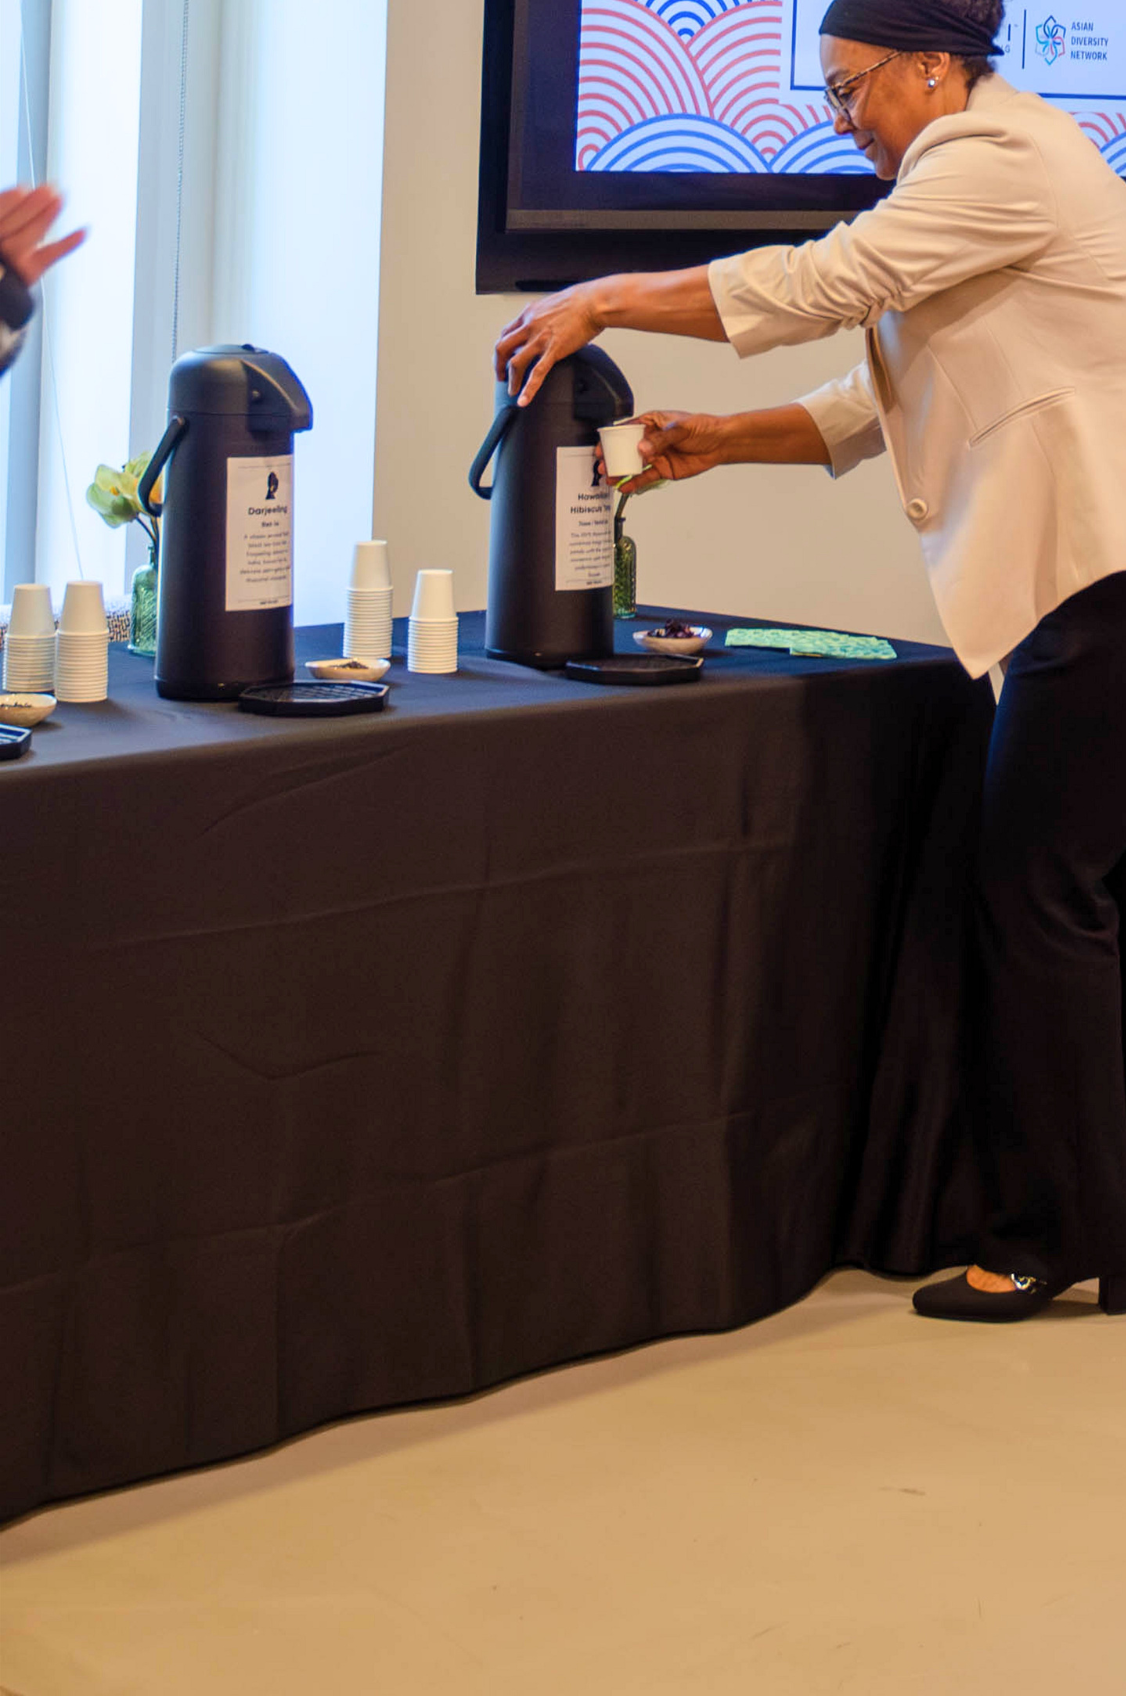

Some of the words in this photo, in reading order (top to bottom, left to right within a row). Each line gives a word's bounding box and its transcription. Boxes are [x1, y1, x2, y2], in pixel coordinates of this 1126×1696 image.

[1071, 21, 1094, 32] ASIAN
[1070, 36, 1109, 47] DIVERSITY
[1070, 50, 1108, 61] NETWORK
[247, 504, 288, 517] Darjeeling
